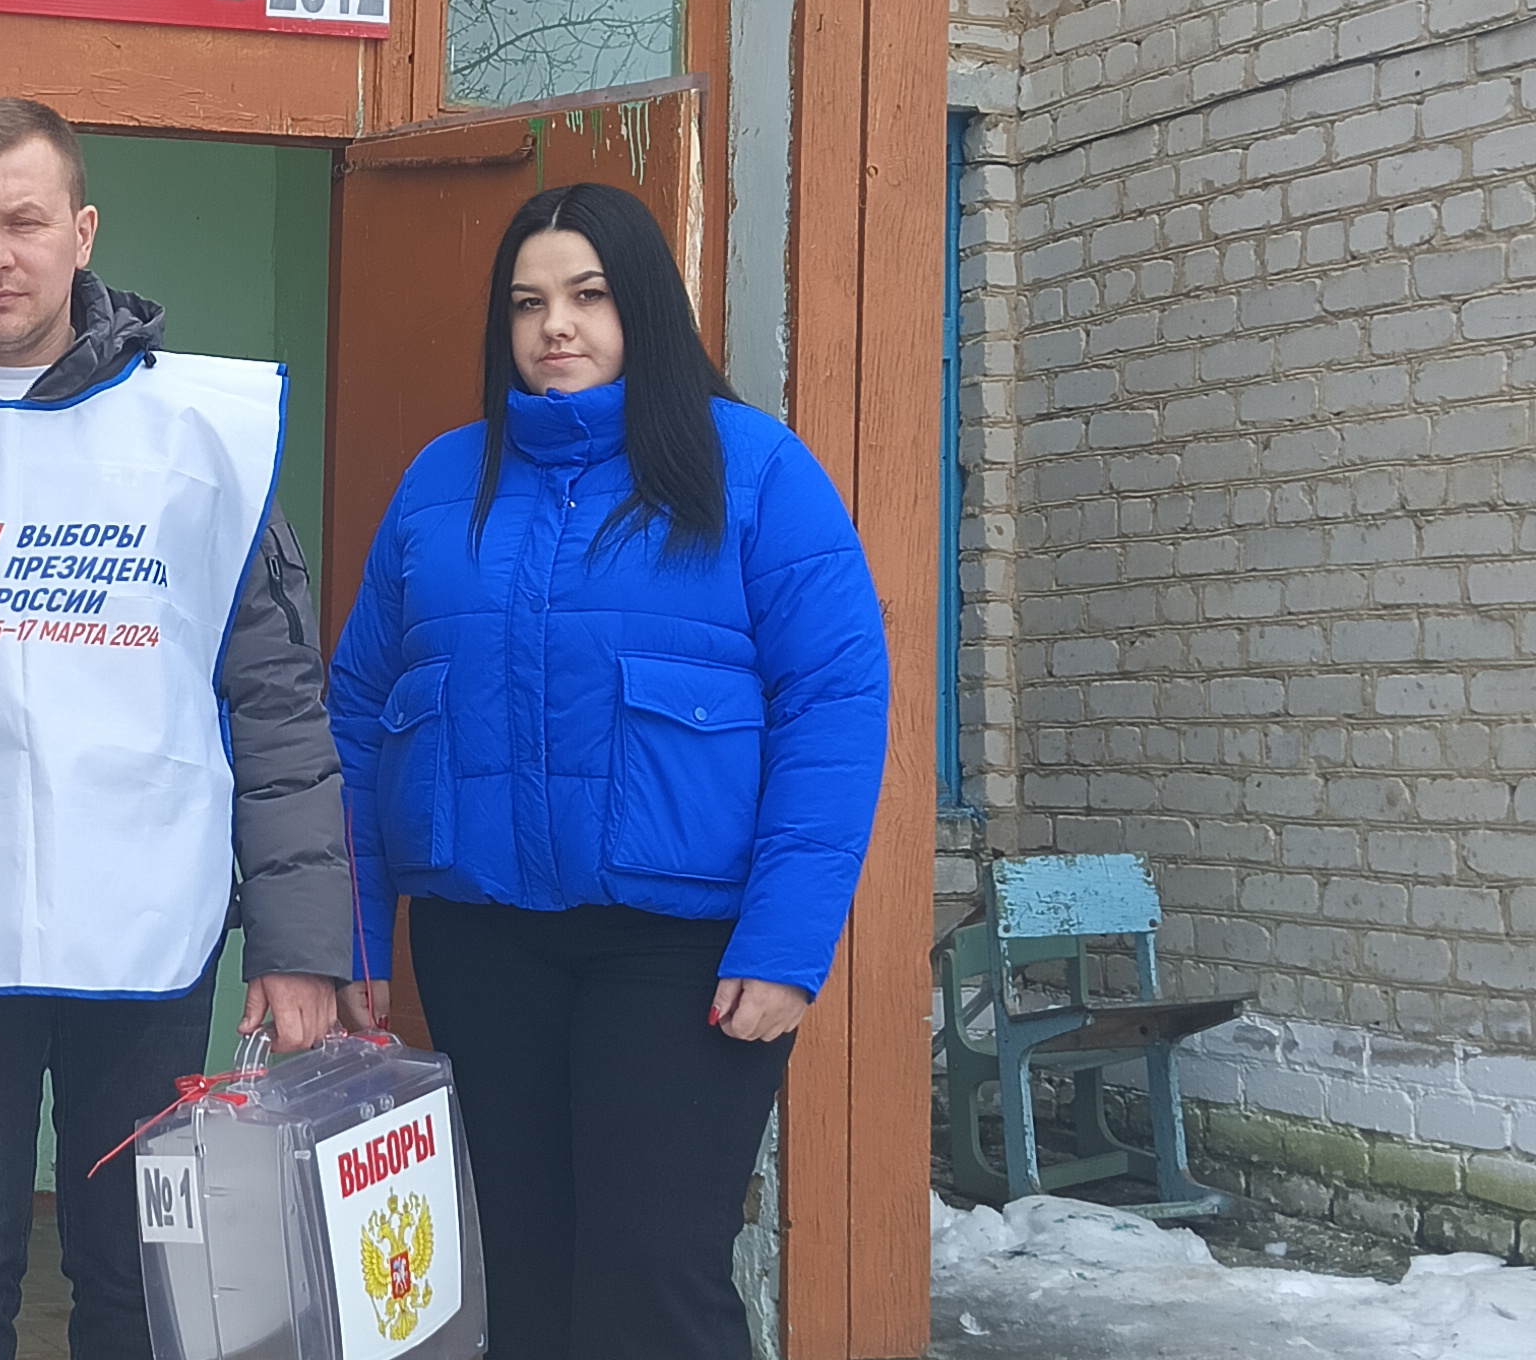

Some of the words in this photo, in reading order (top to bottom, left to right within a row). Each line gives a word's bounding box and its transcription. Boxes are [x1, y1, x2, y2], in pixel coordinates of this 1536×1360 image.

[16, 523, 148, 549] ВЫБОРЫ
[3, 555, 169, 589] ПРЕЗИДЕНТА
[38, 621, 107, 645] МАРТА
[109, 624, 161, 647] 2024
[337, 1113, 436, 1200] ВЫБОРЫ
[143, 1166, 174, 1229] №
[180, 1166, 195, 1229] 1
